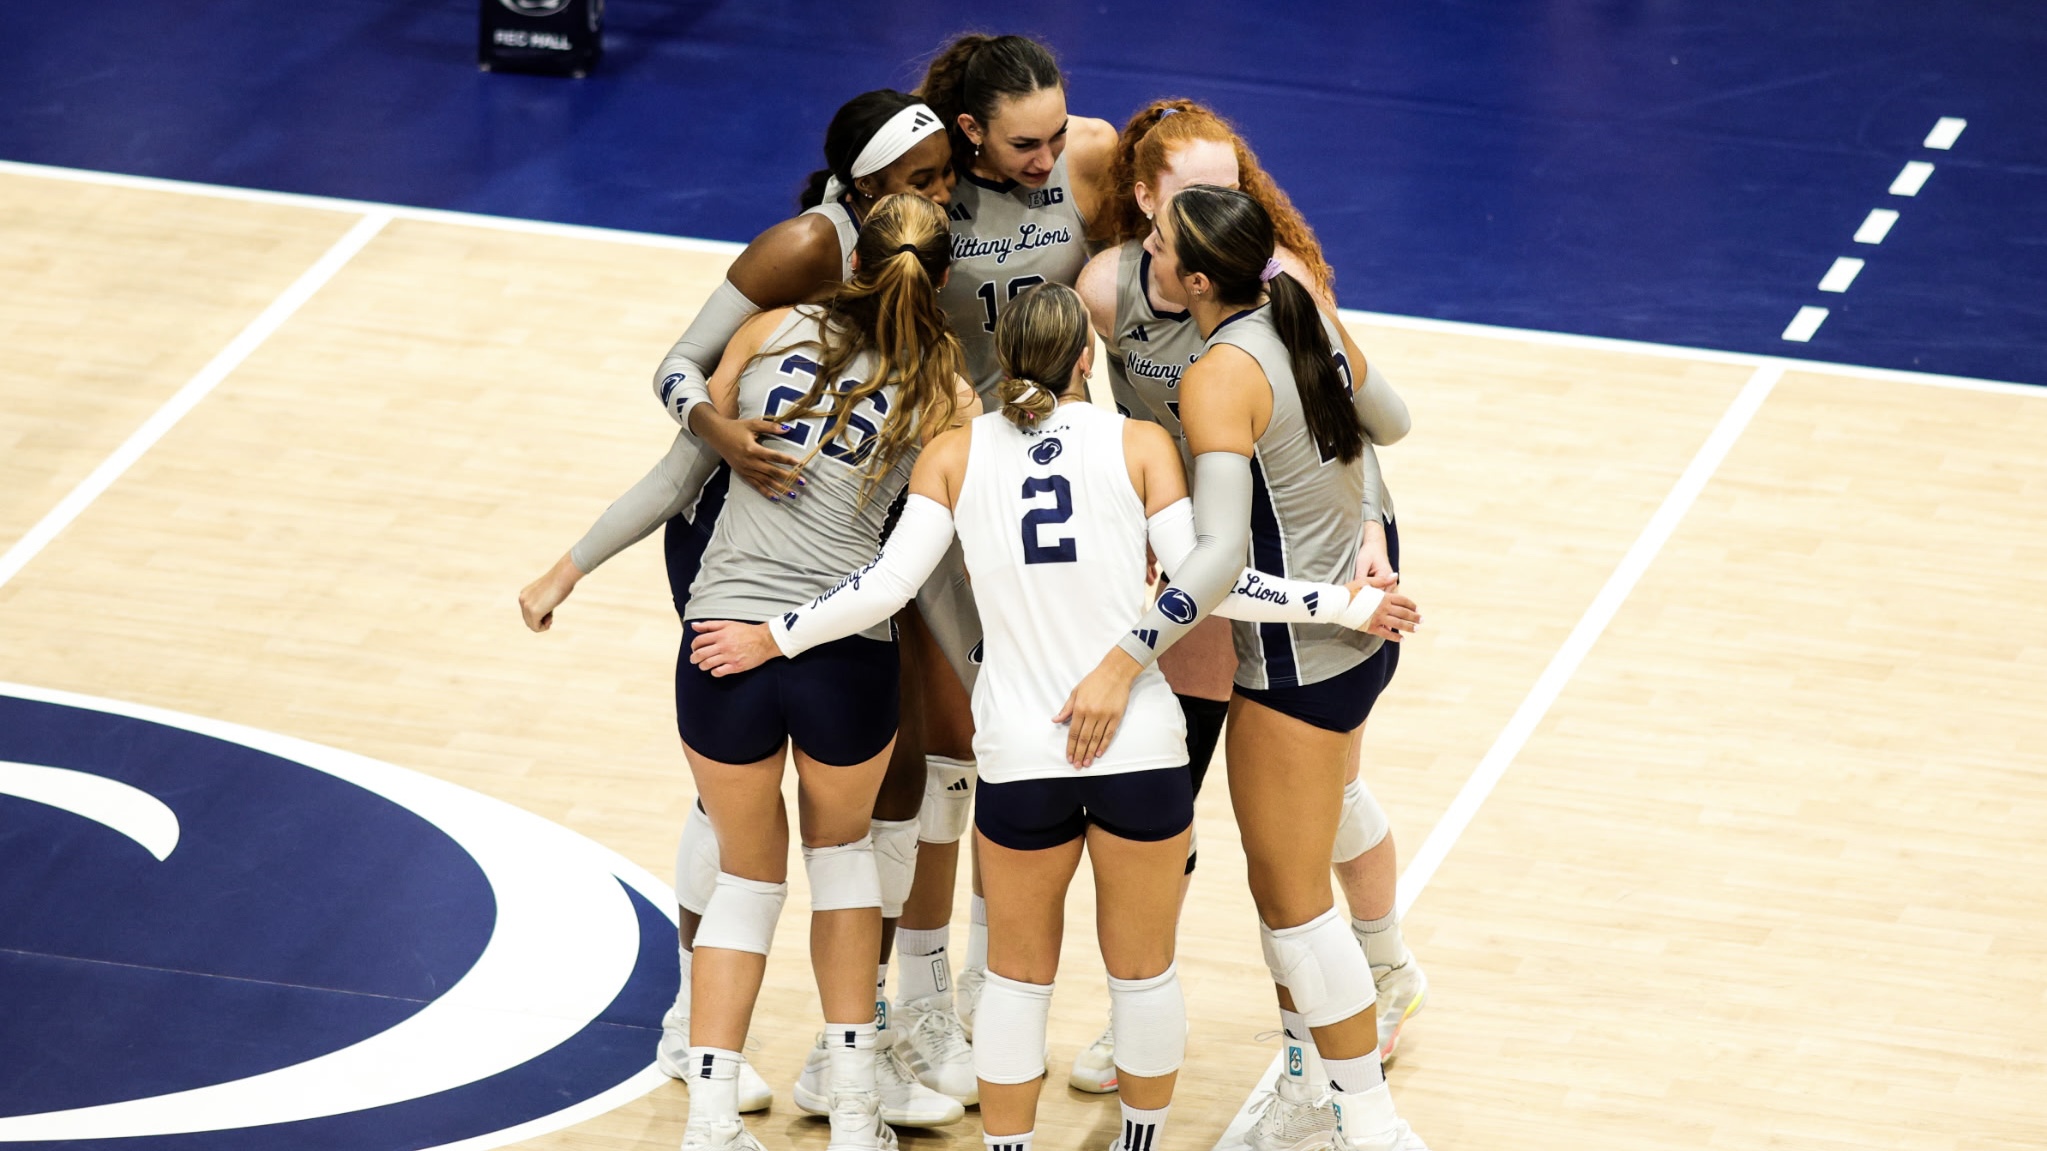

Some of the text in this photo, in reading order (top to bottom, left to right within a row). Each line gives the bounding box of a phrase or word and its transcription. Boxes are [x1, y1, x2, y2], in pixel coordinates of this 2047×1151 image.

[1014, 223, 1072, 251] Lions
[1126, 351, 1182, 389] Nittany
[762, 352, 892, 469] 26
[1021, 474, 1077, 565] 2
[1237, 572, 1289, 606] Lions
